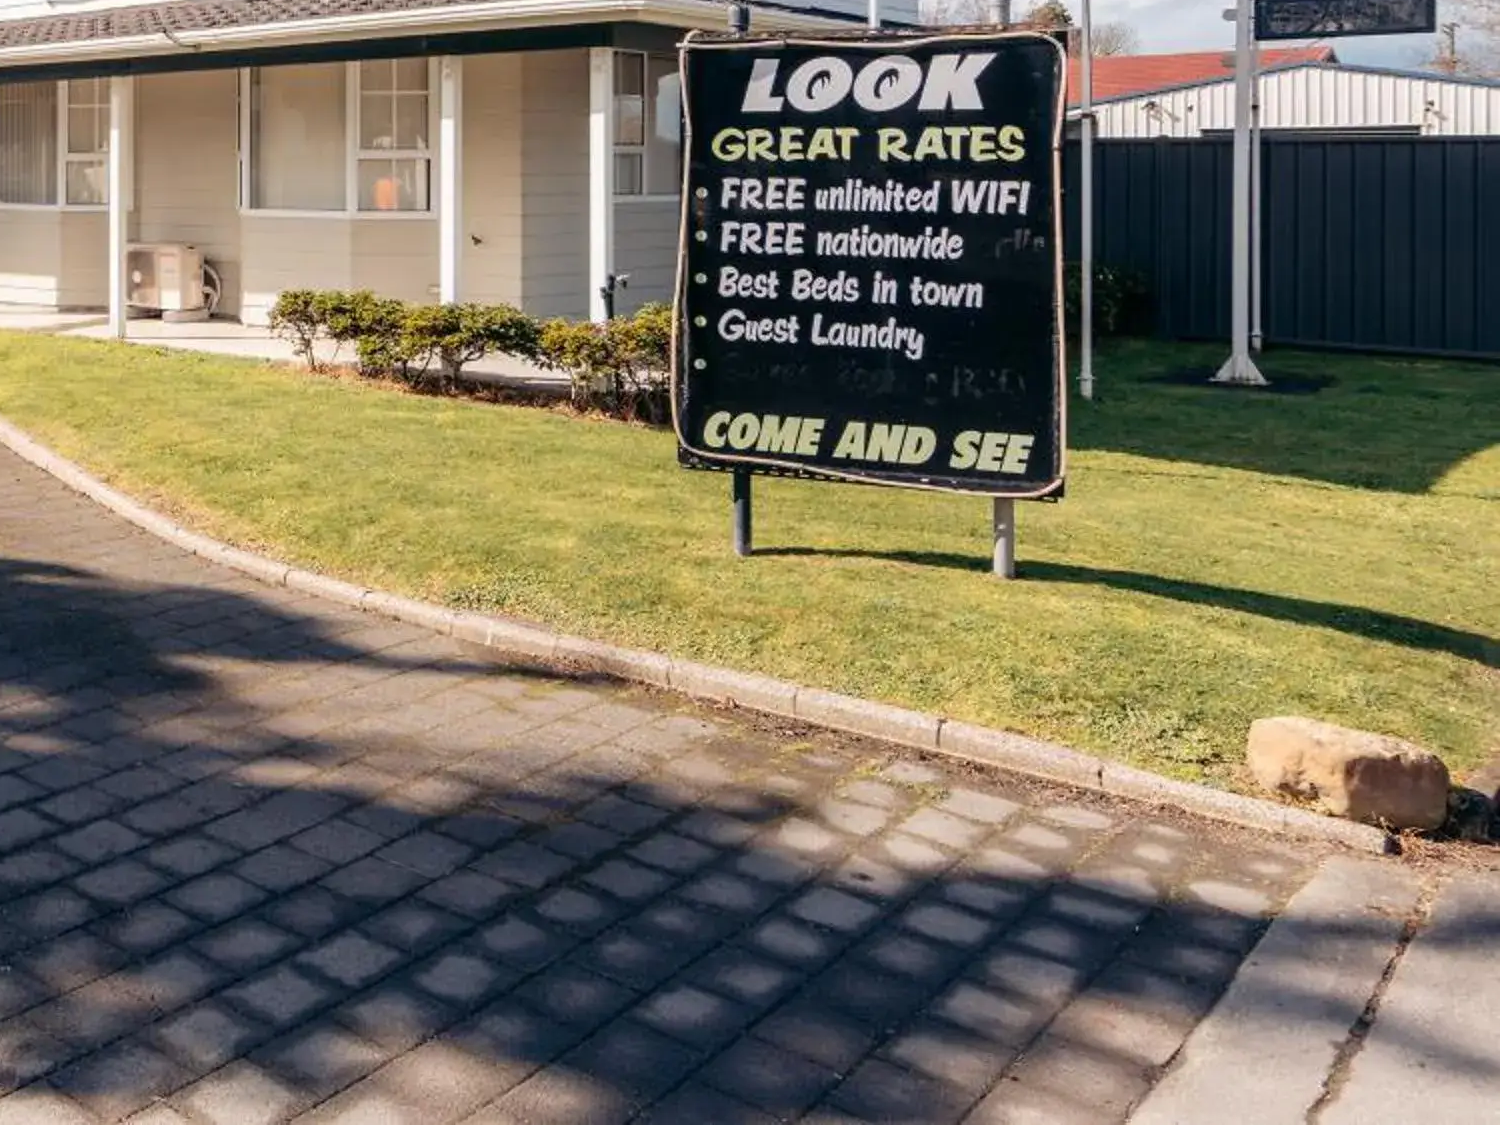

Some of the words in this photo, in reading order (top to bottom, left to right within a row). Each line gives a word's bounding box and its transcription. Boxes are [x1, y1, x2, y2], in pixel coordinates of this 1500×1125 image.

[741, 53, 997, 112] LOOK
[712, 127, 859, 161] GREAT
[878, 125, 1024, 161] RATES
[721, 178, 806, 210] FREE
[815, 179, 940, 212] unlimited
[952, 180, 1030, 215] WIFI
[721, 221, 805, 255] FREE
[817, 225, 963, 259] nationwide
[719, 266, 779, 298] Best
[792, 269, 859, 301] Beds
[872, 271, 897, 304] in
[910, 277, 983, 307] town
[718, 309, 799, 343] Guest
[812, 314, 924, 360] Laundry
[703, 411, 824, 455] COME
[833, 422, 936, 464] AND
[949, 431, 1034, 474] SEE
